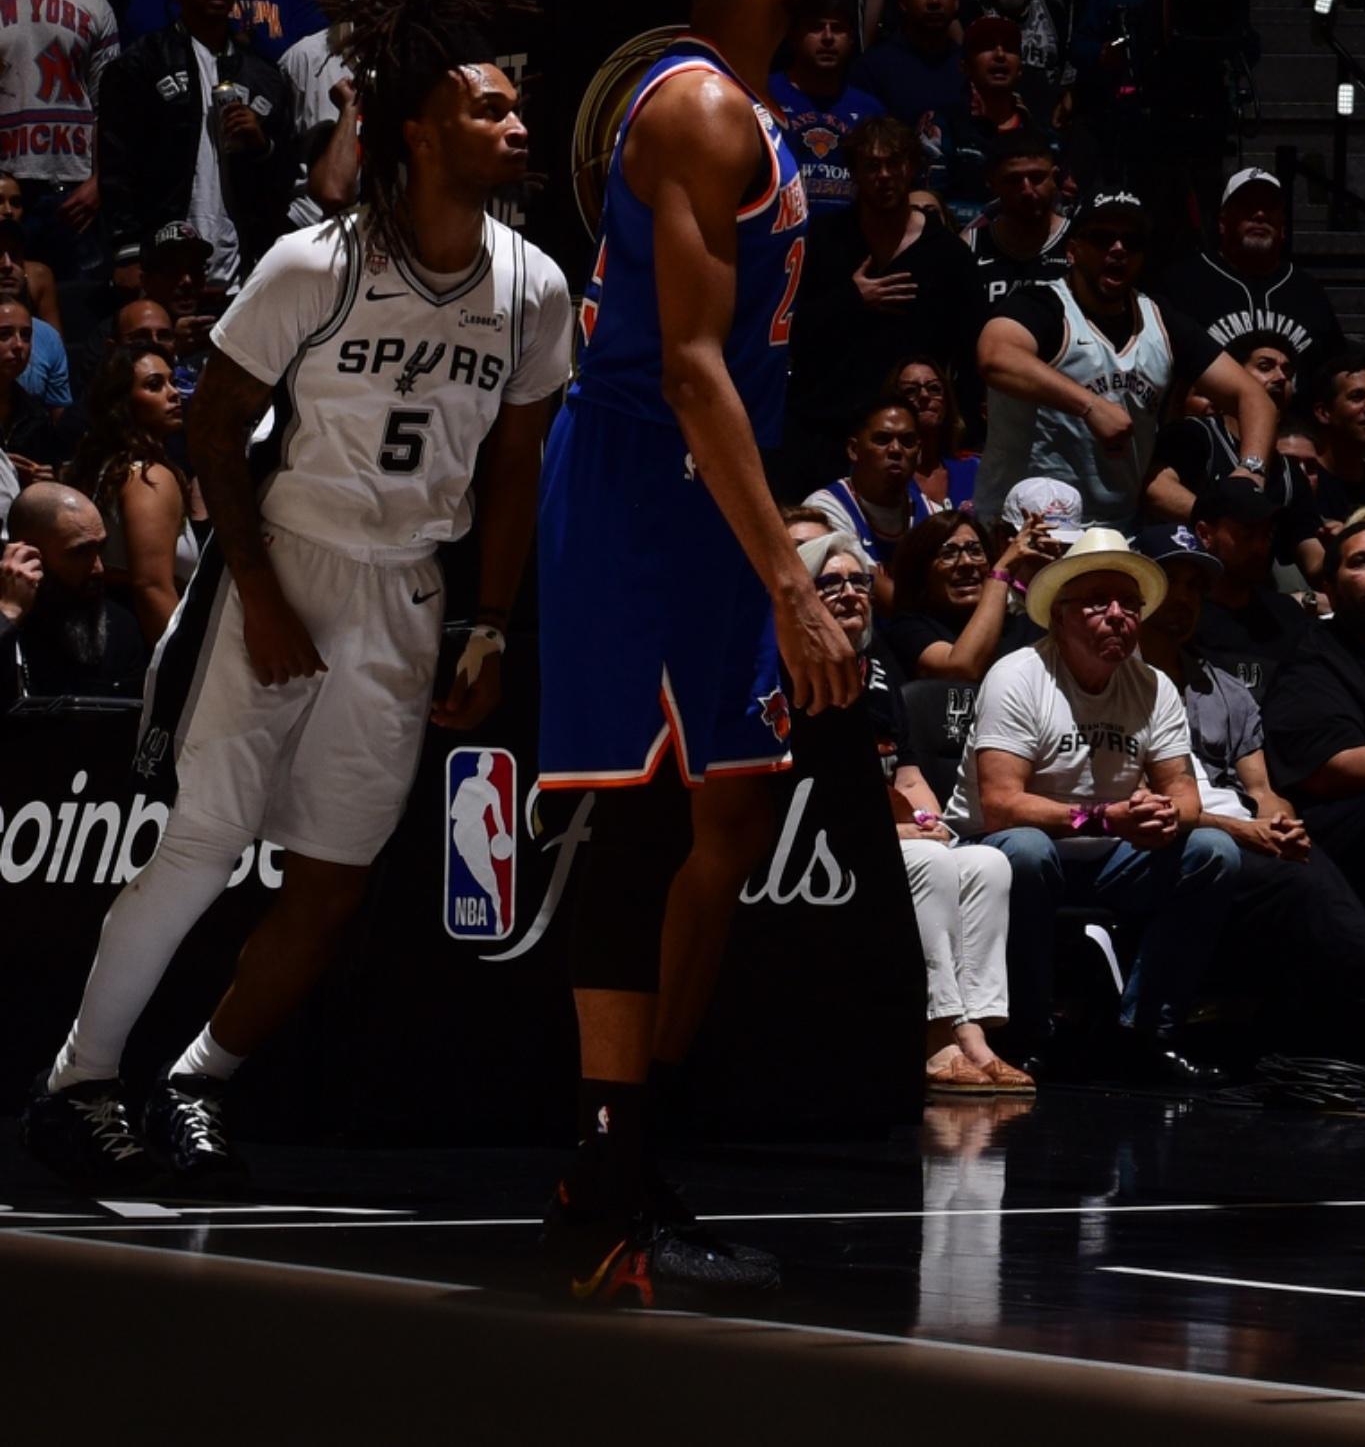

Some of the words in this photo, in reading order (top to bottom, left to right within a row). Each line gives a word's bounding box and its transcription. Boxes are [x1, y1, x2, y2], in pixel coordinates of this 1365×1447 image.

[0, 123, 88, 162] NICKS
[337, 340, 505, 397] SPURS
[378, 409, 433, 475] 5
[0, 769, 285, 891] oinbe
[454, 895, 488, 927] NBA
